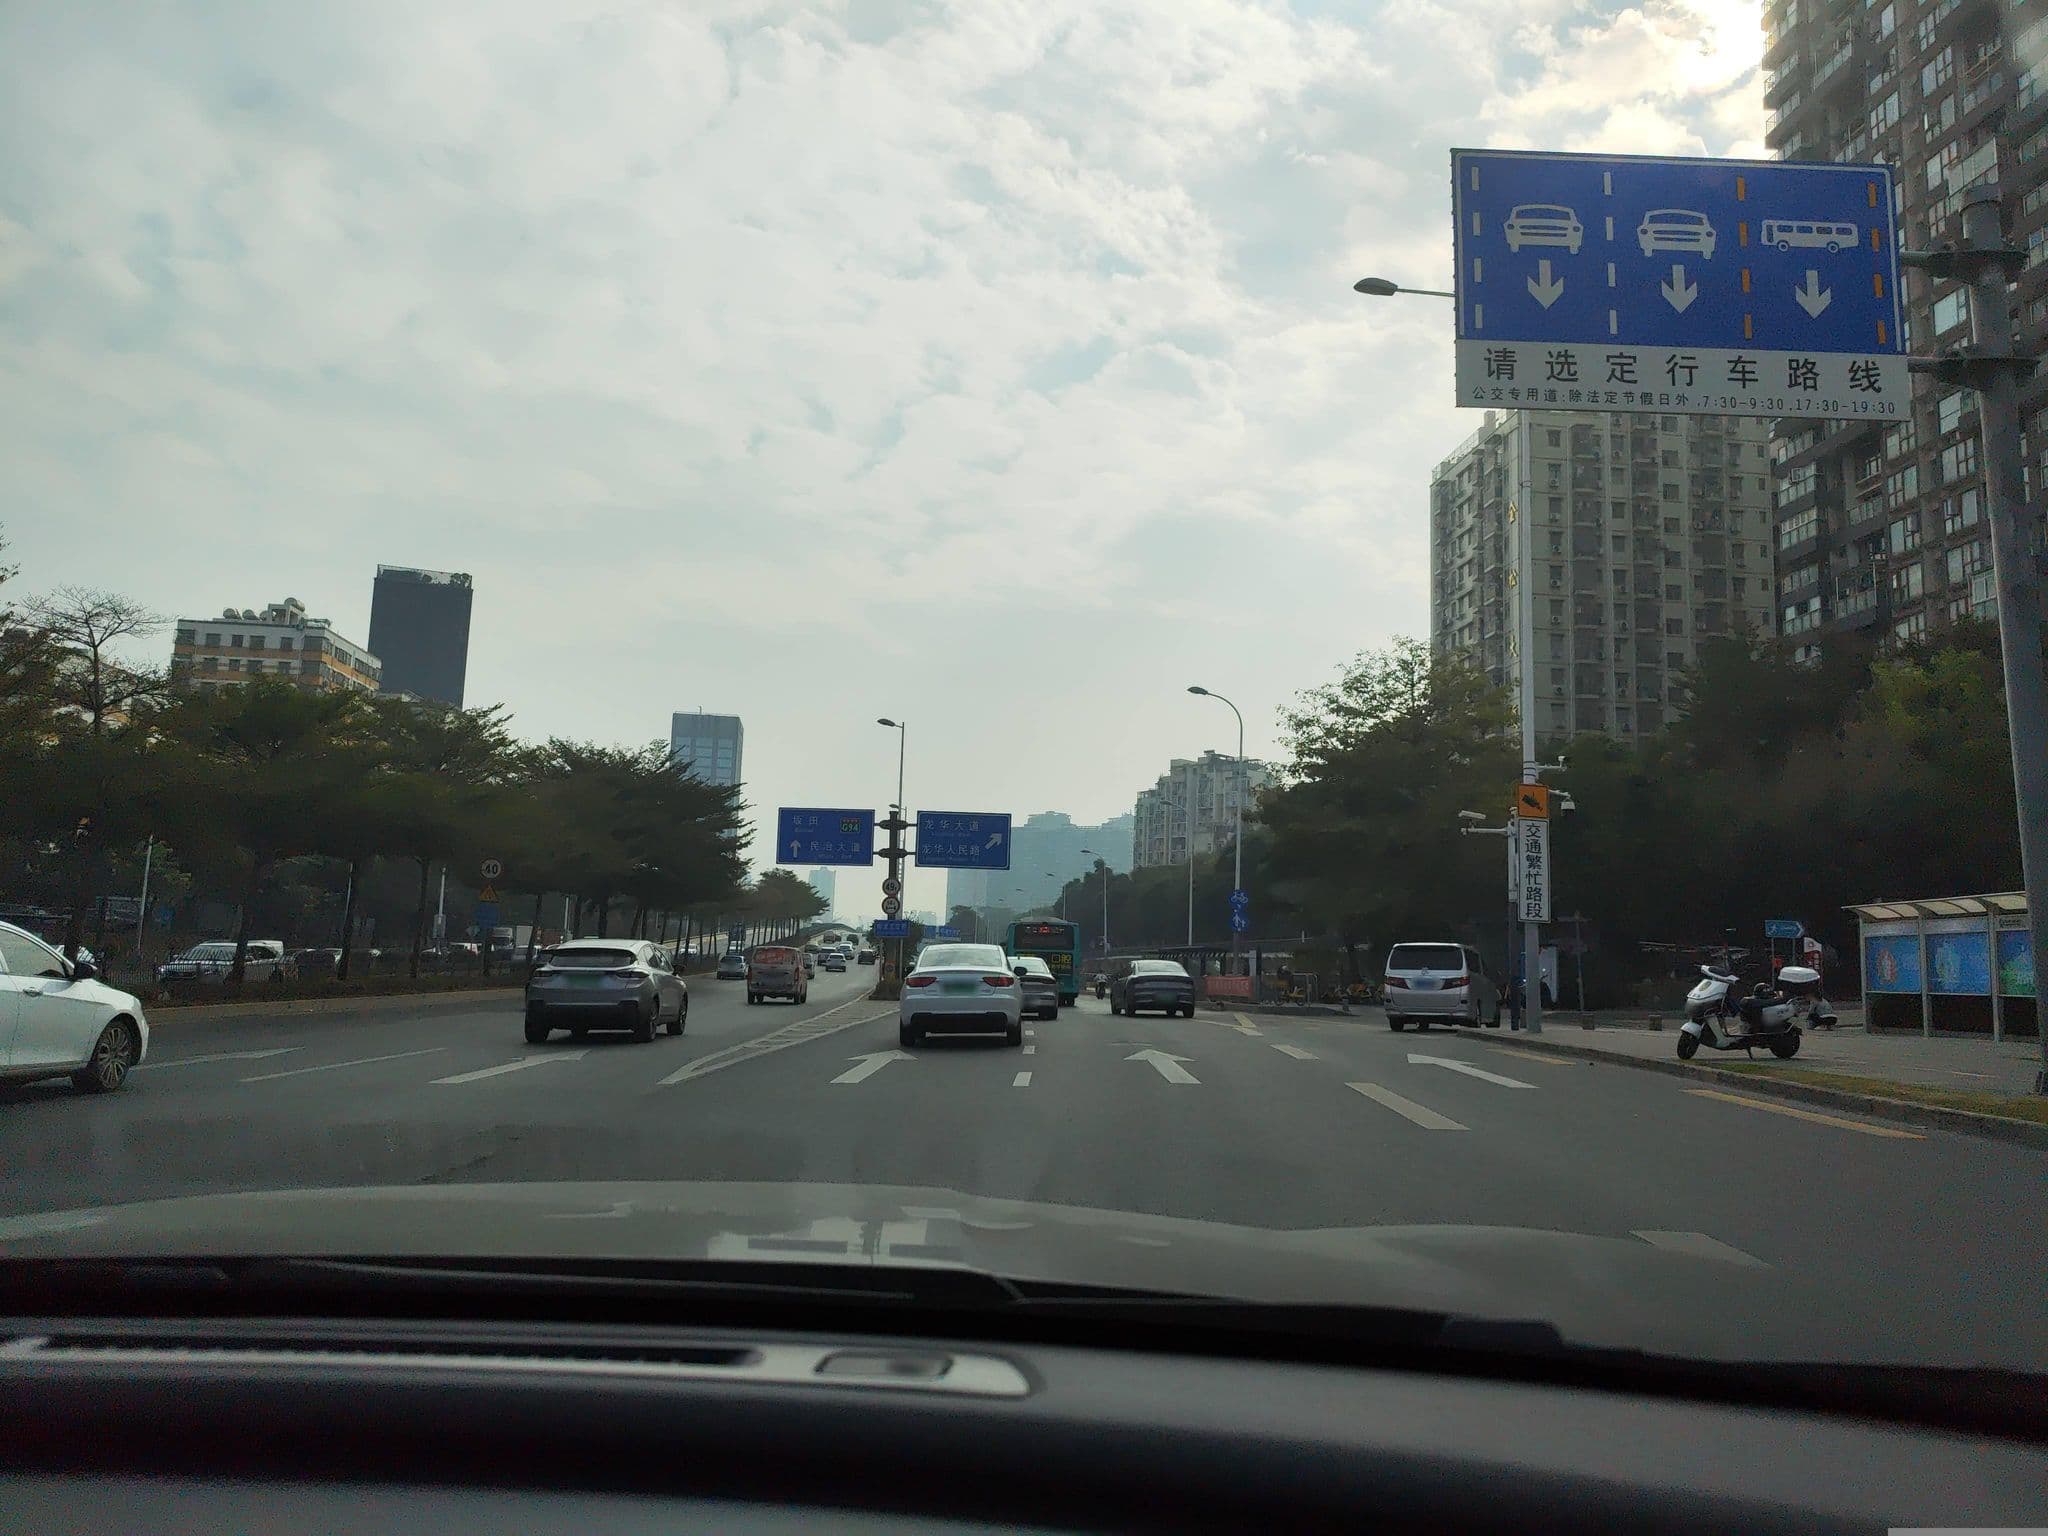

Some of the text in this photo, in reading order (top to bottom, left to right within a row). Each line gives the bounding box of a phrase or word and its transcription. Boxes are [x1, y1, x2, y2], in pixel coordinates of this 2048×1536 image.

[1484, 347, 1882, 393] 请选定行车路线
[842, 823, 859, 832] G94
[485, 863, 498, 875] 40
[1525, 823, 1543, 919] 交通繁忙路段
